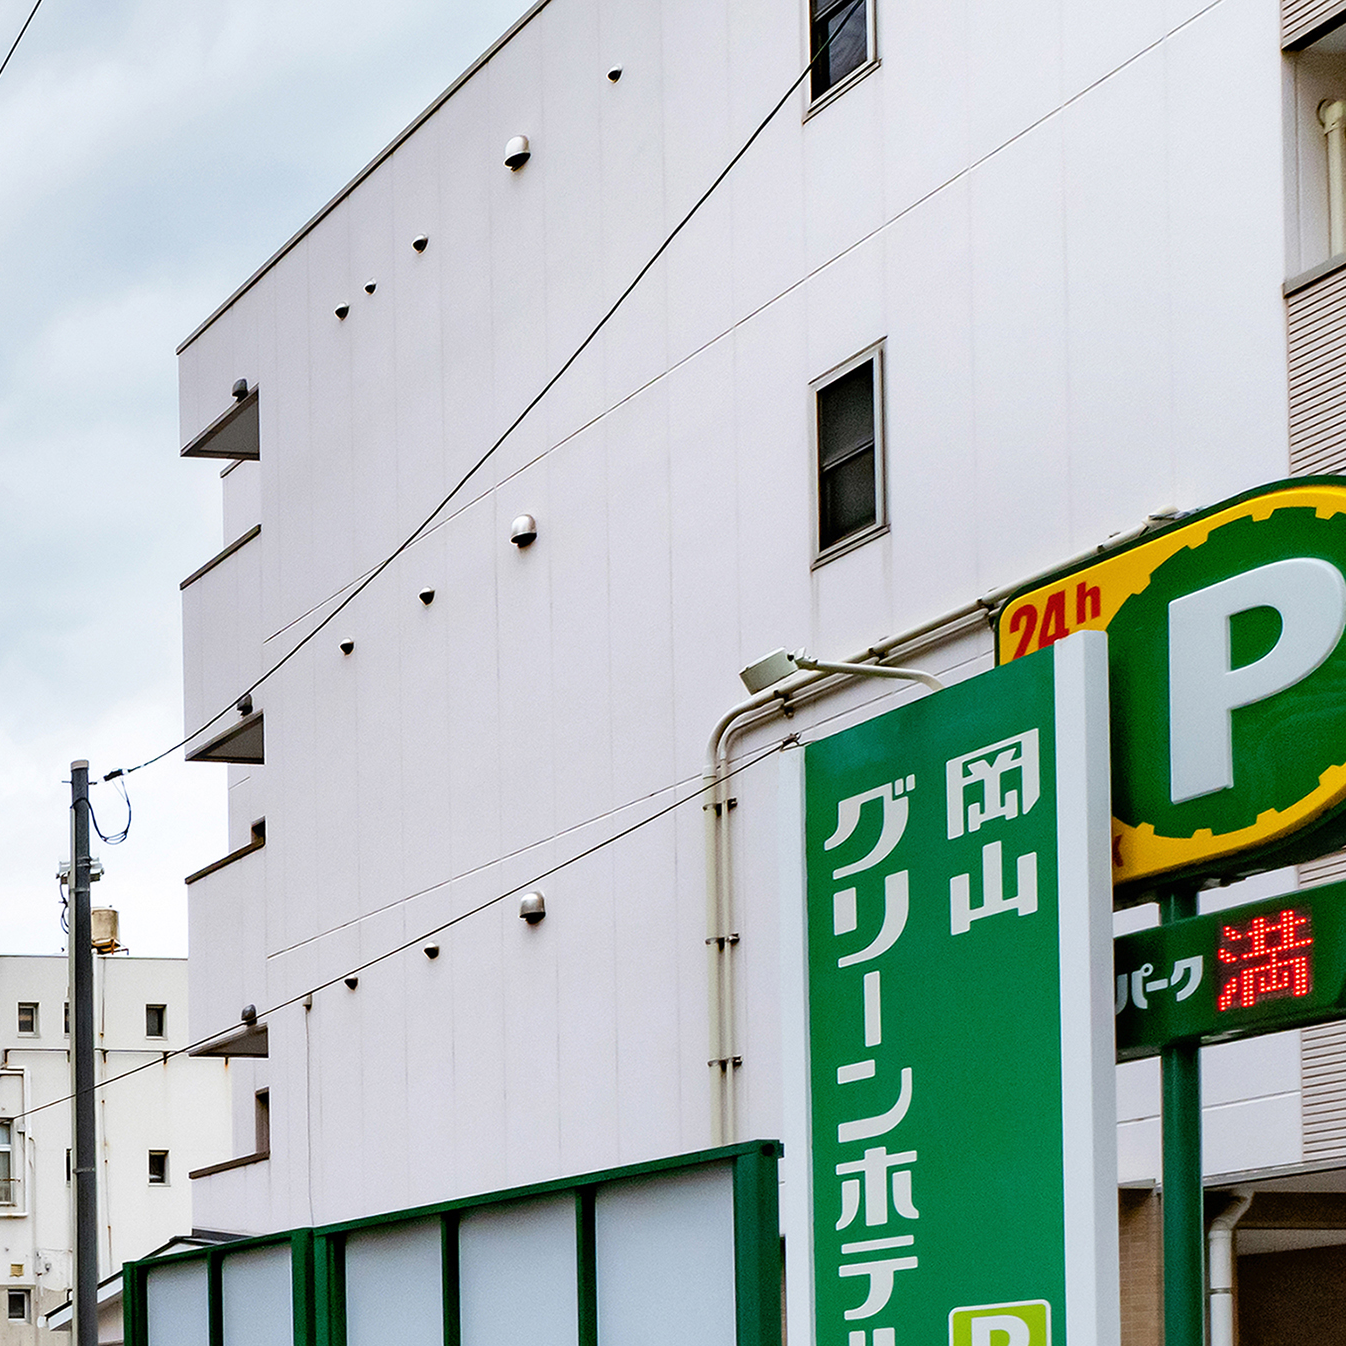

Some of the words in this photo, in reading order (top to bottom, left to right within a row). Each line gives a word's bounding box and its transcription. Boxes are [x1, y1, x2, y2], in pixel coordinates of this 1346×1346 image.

[1010, 581, 1101, 660] 24h
[1169, 557, 1346, 804] P
[946, 727, 1040, 935] 岡山
[1217, 909, 1314, 1012] 満
